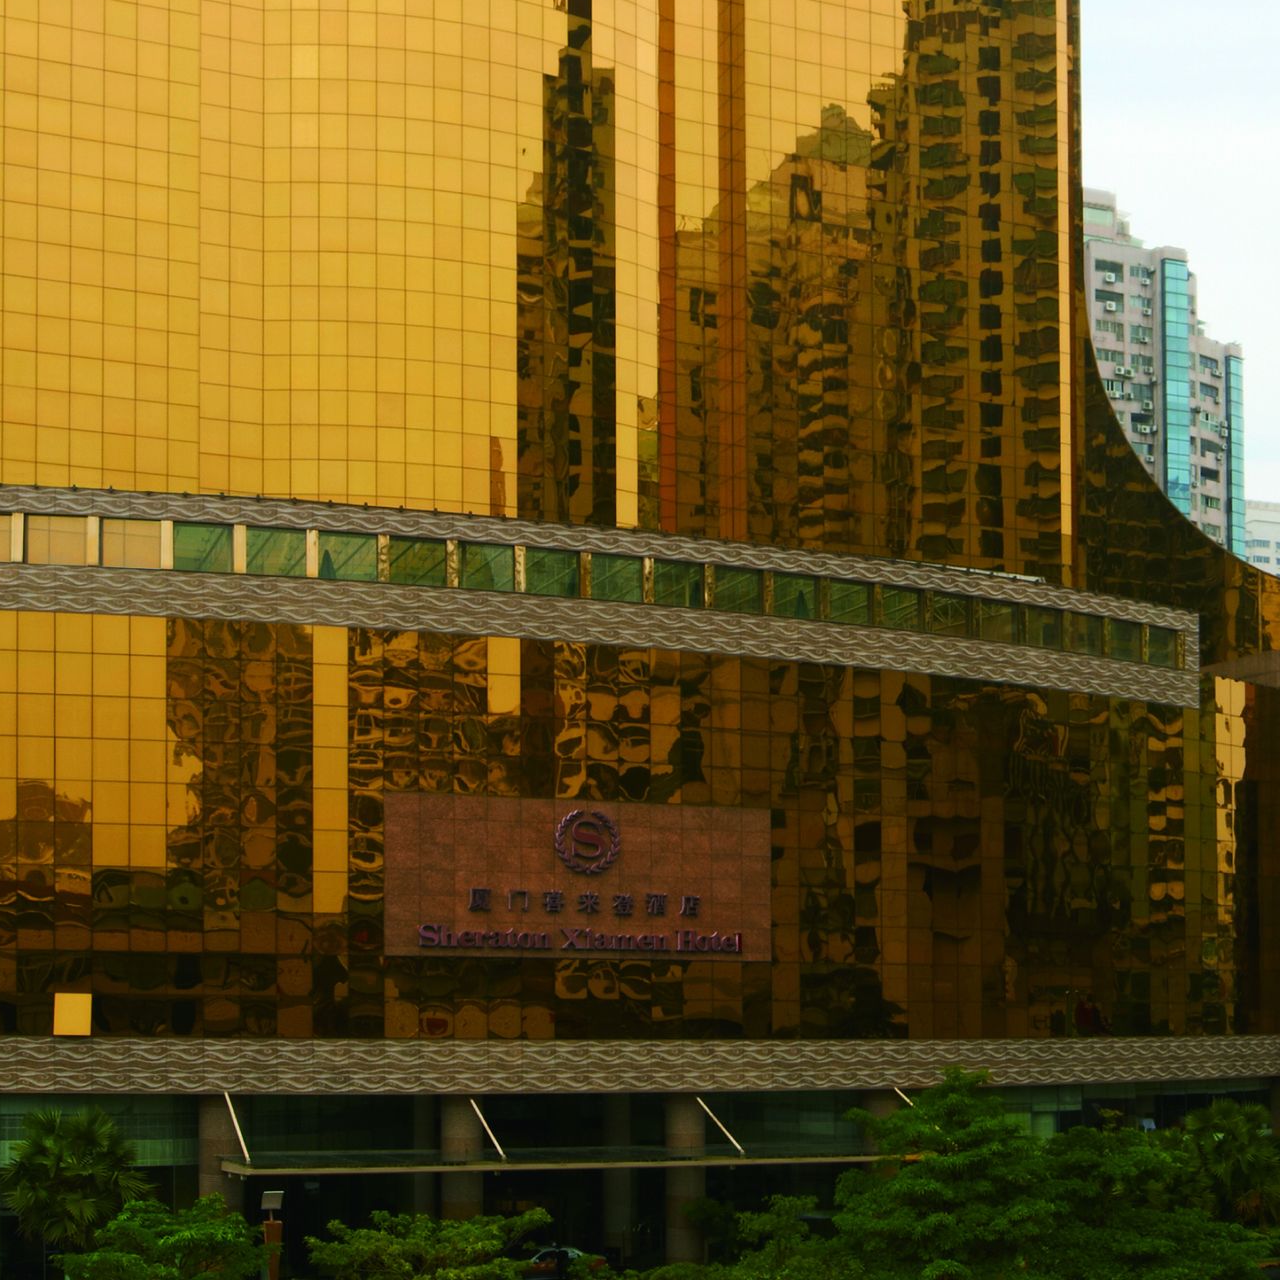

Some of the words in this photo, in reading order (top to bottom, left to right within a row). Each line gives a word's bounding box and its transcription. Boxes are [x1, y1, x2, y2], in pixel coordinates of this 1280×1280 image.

[572, 820, 604, 858] S
[468, 888, 700, 916] 厦门喜来登酒店
[418, 923, 551, 949] Sheraton
[560, 927, 670, 951] Xiamen
[675, 929, 742, 952] Hotel
